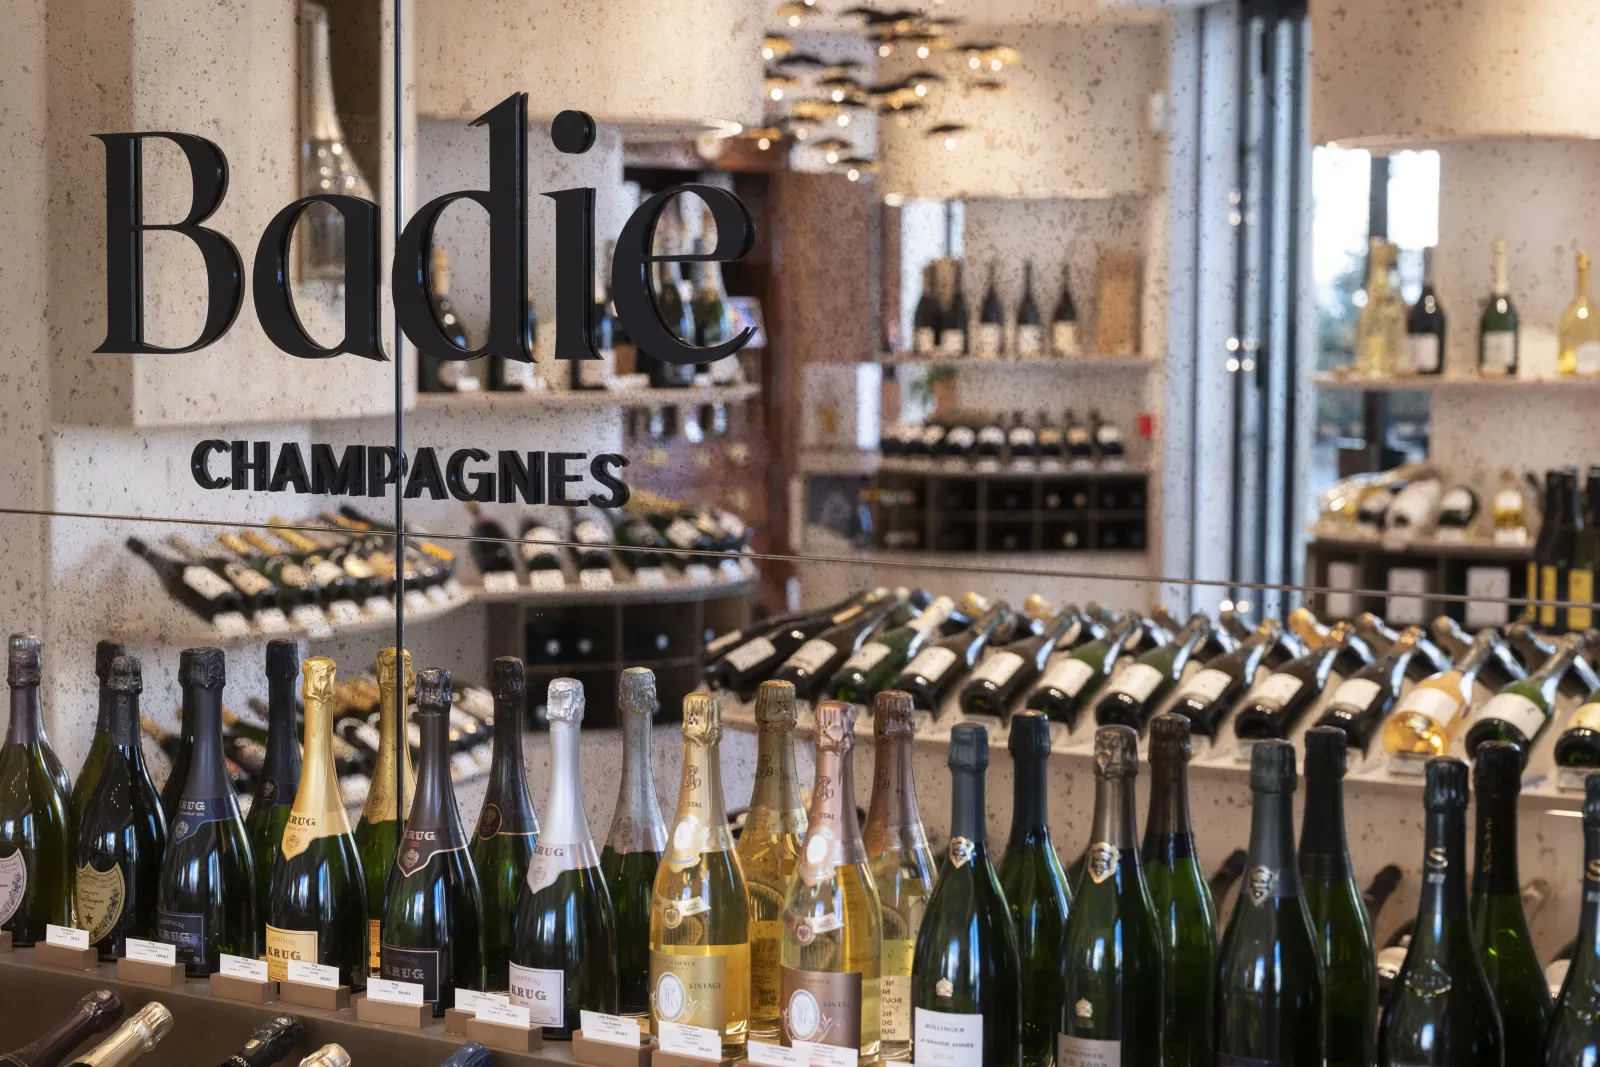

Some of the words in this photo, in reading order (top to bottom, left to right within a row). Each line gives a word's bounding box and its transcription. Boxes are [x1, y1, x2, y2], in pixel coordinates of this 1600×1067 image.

[92, 91, 758, 364] Badie
[190, 438, 630, 508] CHAMPAGNES
[267, 945, 302, 961] KRUG
[385, 964, 425, 980] KRUG
[511, 984, 547, 1001] KRUG
[689, 982, 722, 990] VINTAGE
[924, 1022, 966, 1033] BOLLINGER
